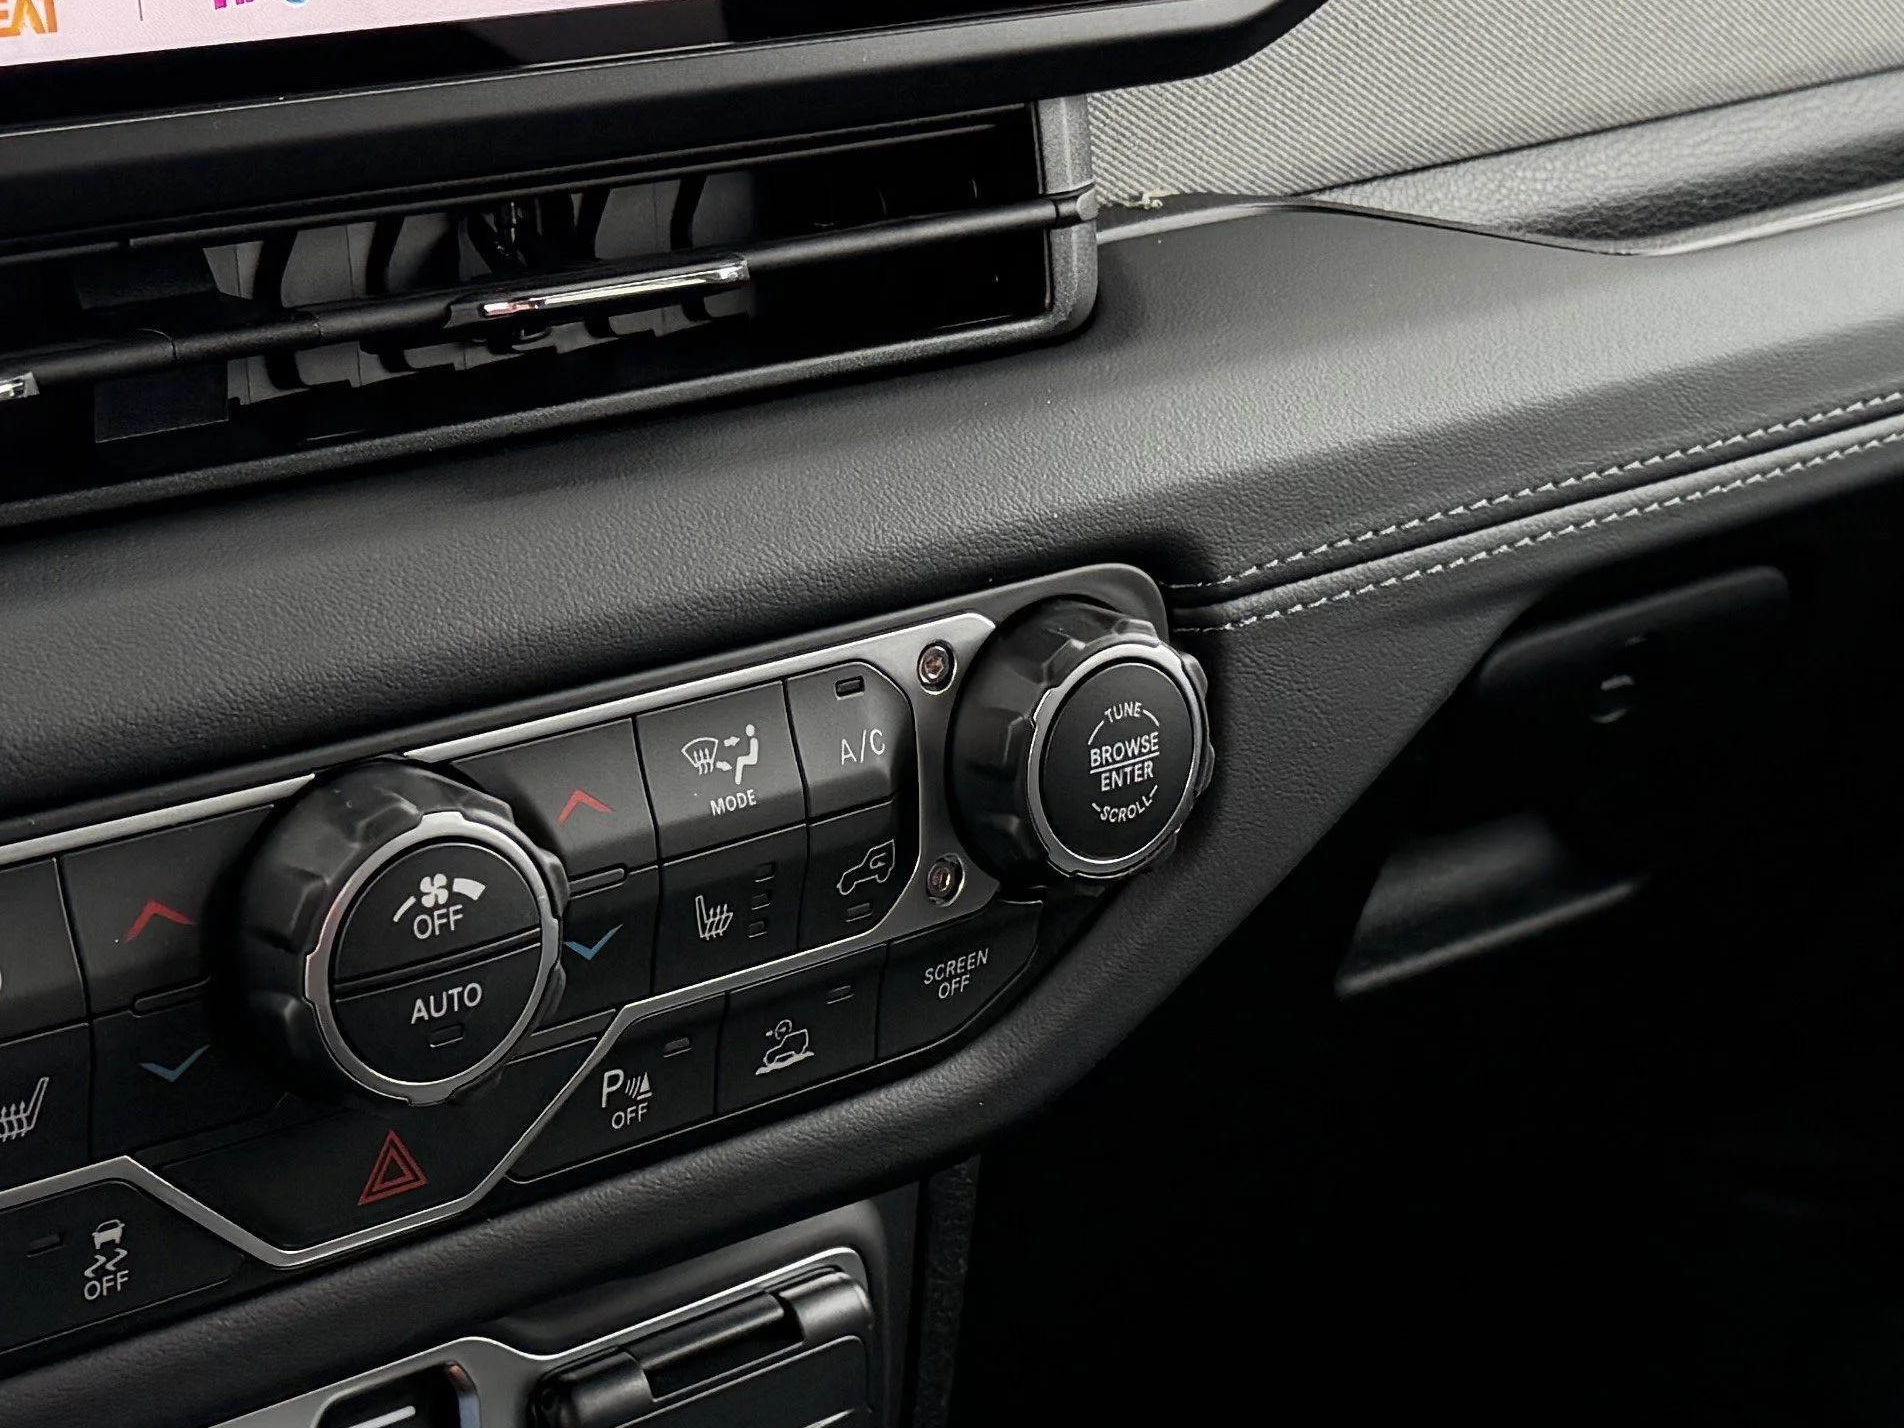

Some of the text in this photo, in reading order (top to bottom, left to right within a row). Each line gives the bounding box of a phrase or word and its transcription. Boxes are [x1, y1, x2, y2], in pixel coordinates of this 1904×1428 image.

[1104, 701, 1143, 723] TUNE
[839, 727, 887, 767] A/C
[1090, 731, 1159, 768] BROWSE
[1100, 760, 1154, 792] ENTER
[709, 788, 758, 817] MODE
[1099, 795, 1154, 824] SCROLL
[412, 903, 465, 941] OFF
[923, 947, 990, 985] SCREEN
[937, 973, 971, 1001] OFF
[409, 982, 484, 1026] AUTO
[611, 1103, 649, 1131] OFF
[83, 1269, 130, 1303] OFF
